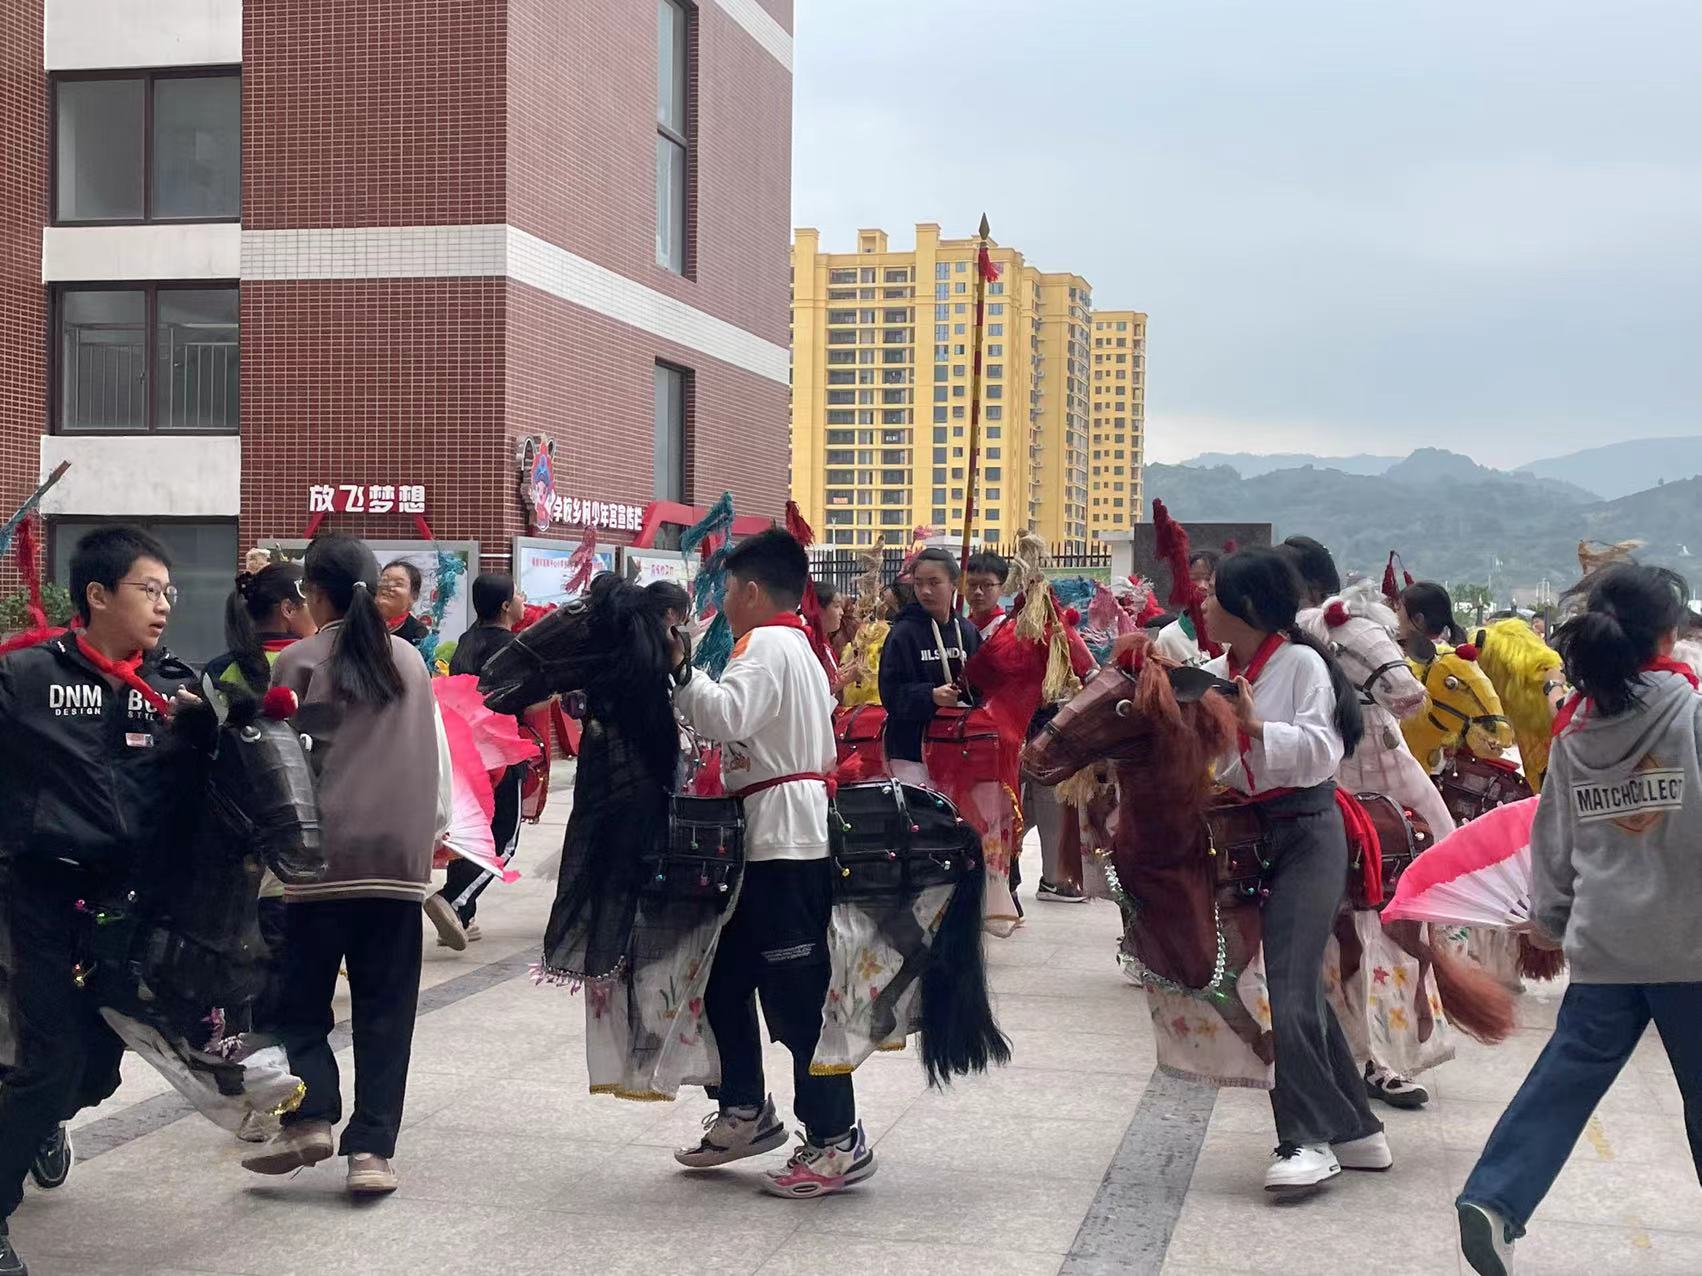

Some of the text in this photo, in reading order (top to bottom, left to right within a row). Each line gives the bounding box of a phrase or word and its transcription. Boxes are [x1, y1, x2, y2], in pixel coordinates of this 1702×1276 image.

[309, 484, 425, 513] 放飞梦想
[50, 684, 103, 708] DNM
[55, 707, 102, 717] DESIGN
